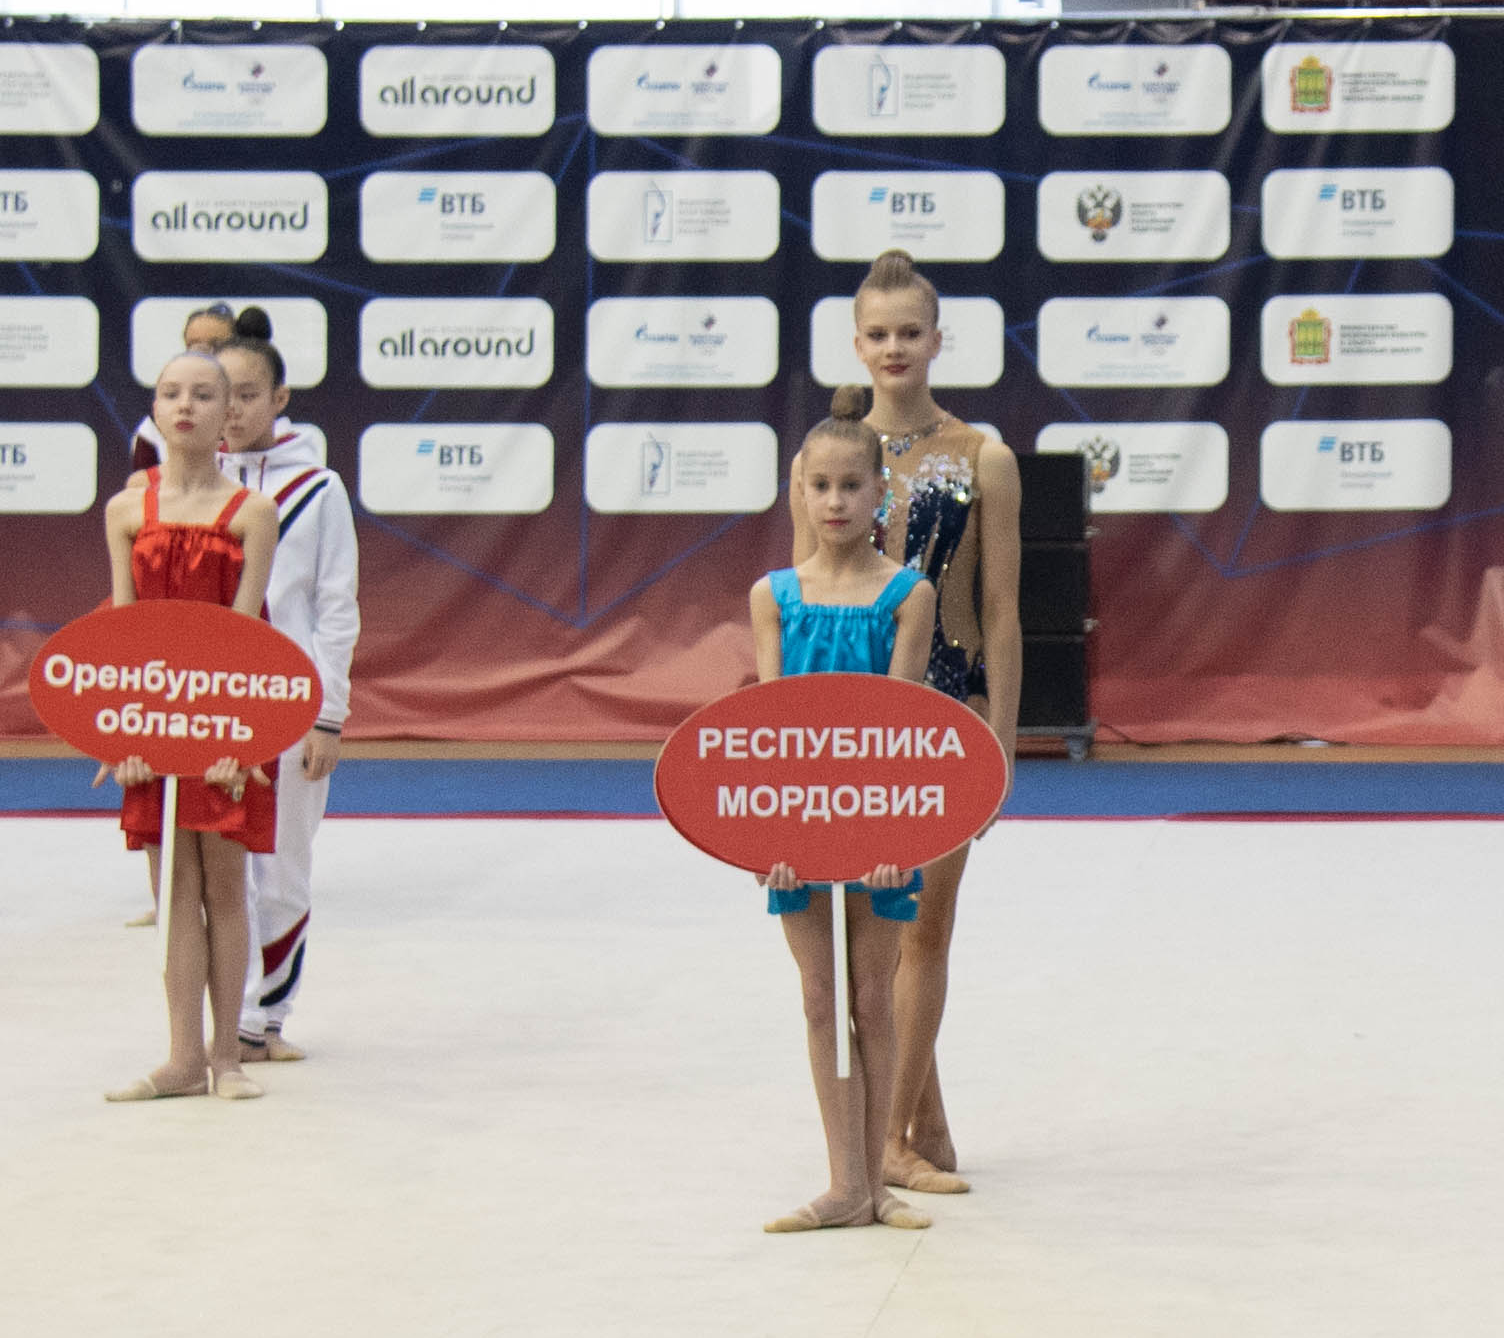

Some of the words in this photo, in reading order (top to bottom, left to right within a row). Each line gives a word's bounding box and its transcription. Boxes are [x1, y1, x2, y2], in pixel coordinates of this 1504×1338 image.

[440, 192, 485, 215] ВТБ
[890, 192, 936, 214] ВТБ
[1341, 188, 1387, 212] ВТБ
[438, 444, 483, 467] ВТБ
[1339, 441, 1385, 464] ВТБ
[44, 652, 313, 702] Оренбургская
[95, 702, 254, 742] область
[697, 725, 967, 760] РЕСПУБЛИКА
[716, 783, 946, 824] МОРДОВИЯ
